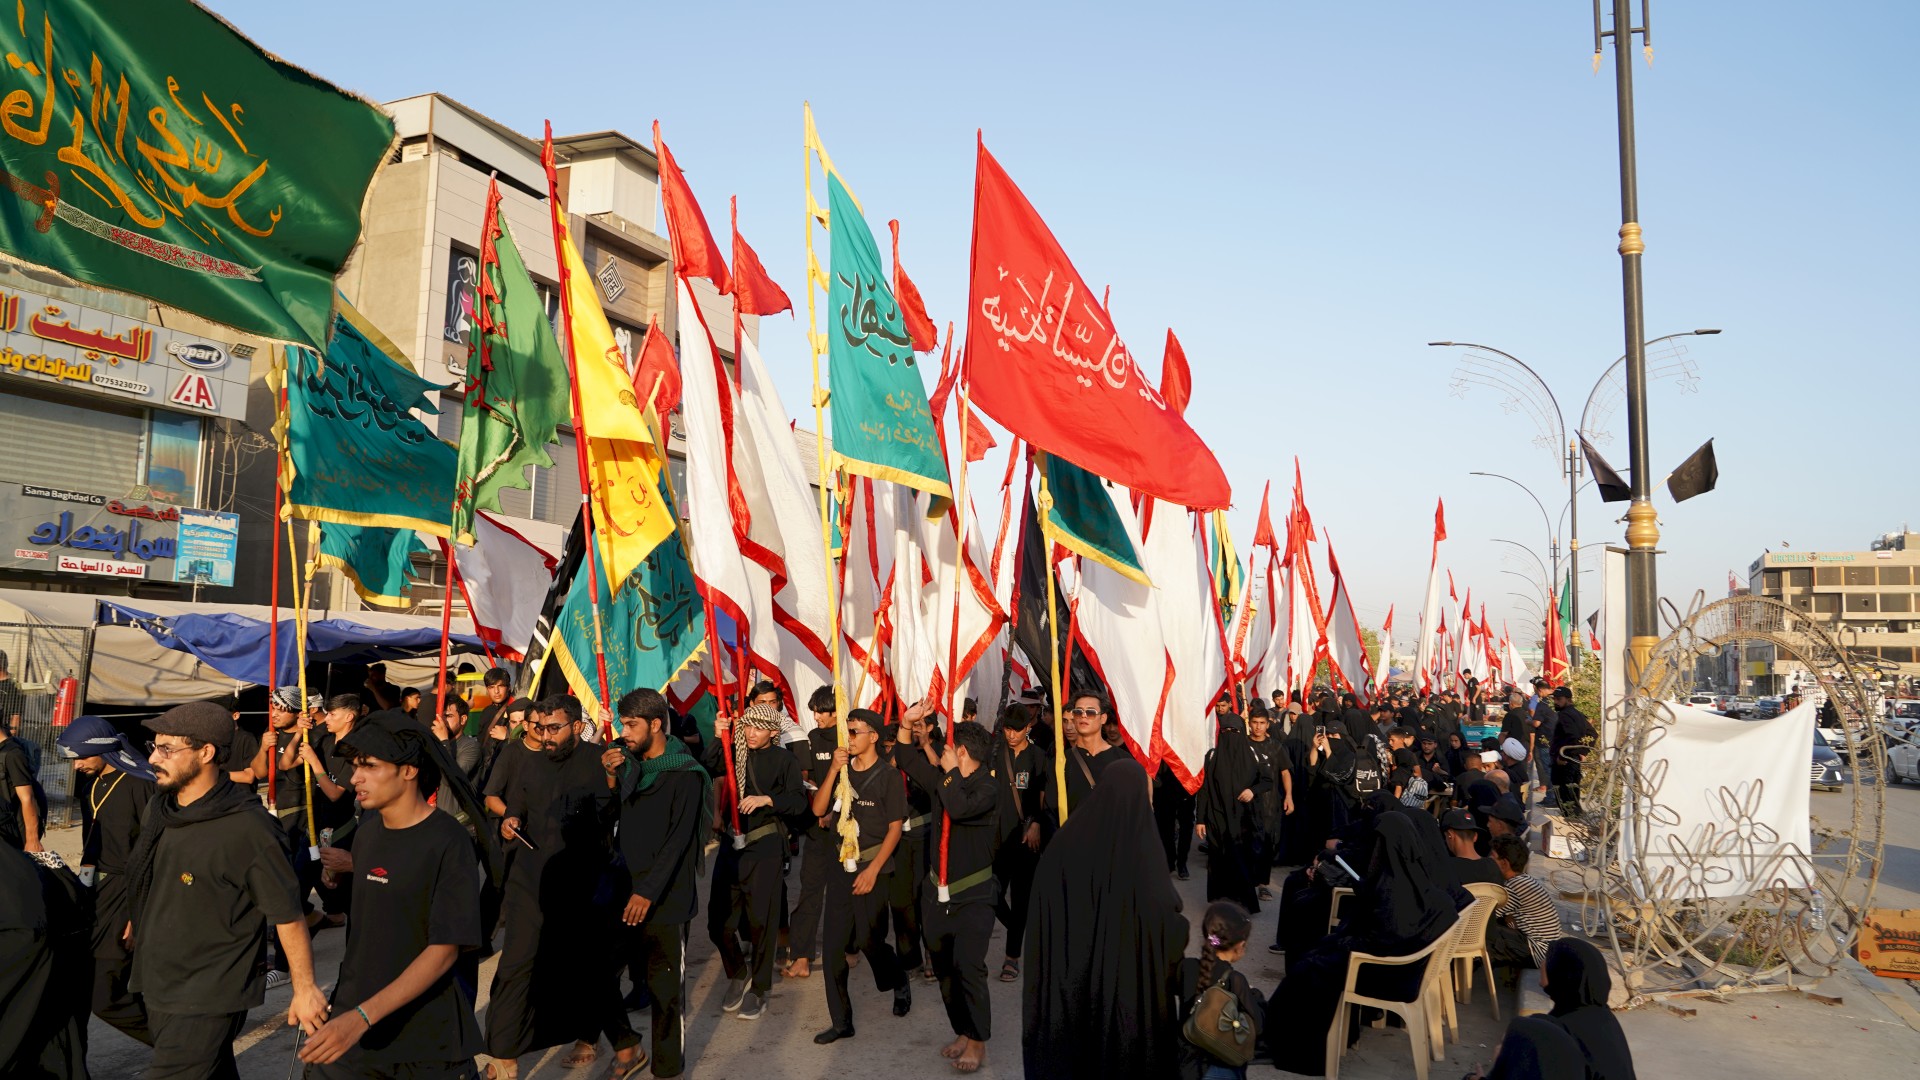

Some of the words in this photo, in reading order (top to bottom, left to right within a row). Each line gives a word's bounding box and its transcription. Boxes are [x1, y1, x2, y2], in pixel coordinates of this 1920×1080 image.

[30, 304, 153, 367] البيت
[167, 340, 220, 364] Copart
[94, 375, 148, 393] 07753230772
[25, 486, 51, 497] Sama
[51, 490, 89, 502] Baghdad
[90, 495, 103, 505] Co.
[106, 500, 180, 521] شركة
[28, 510, 124, 560] بغداد
[128, 518, 177, 560] سما
[115, 565, 143, 575] للسفر
